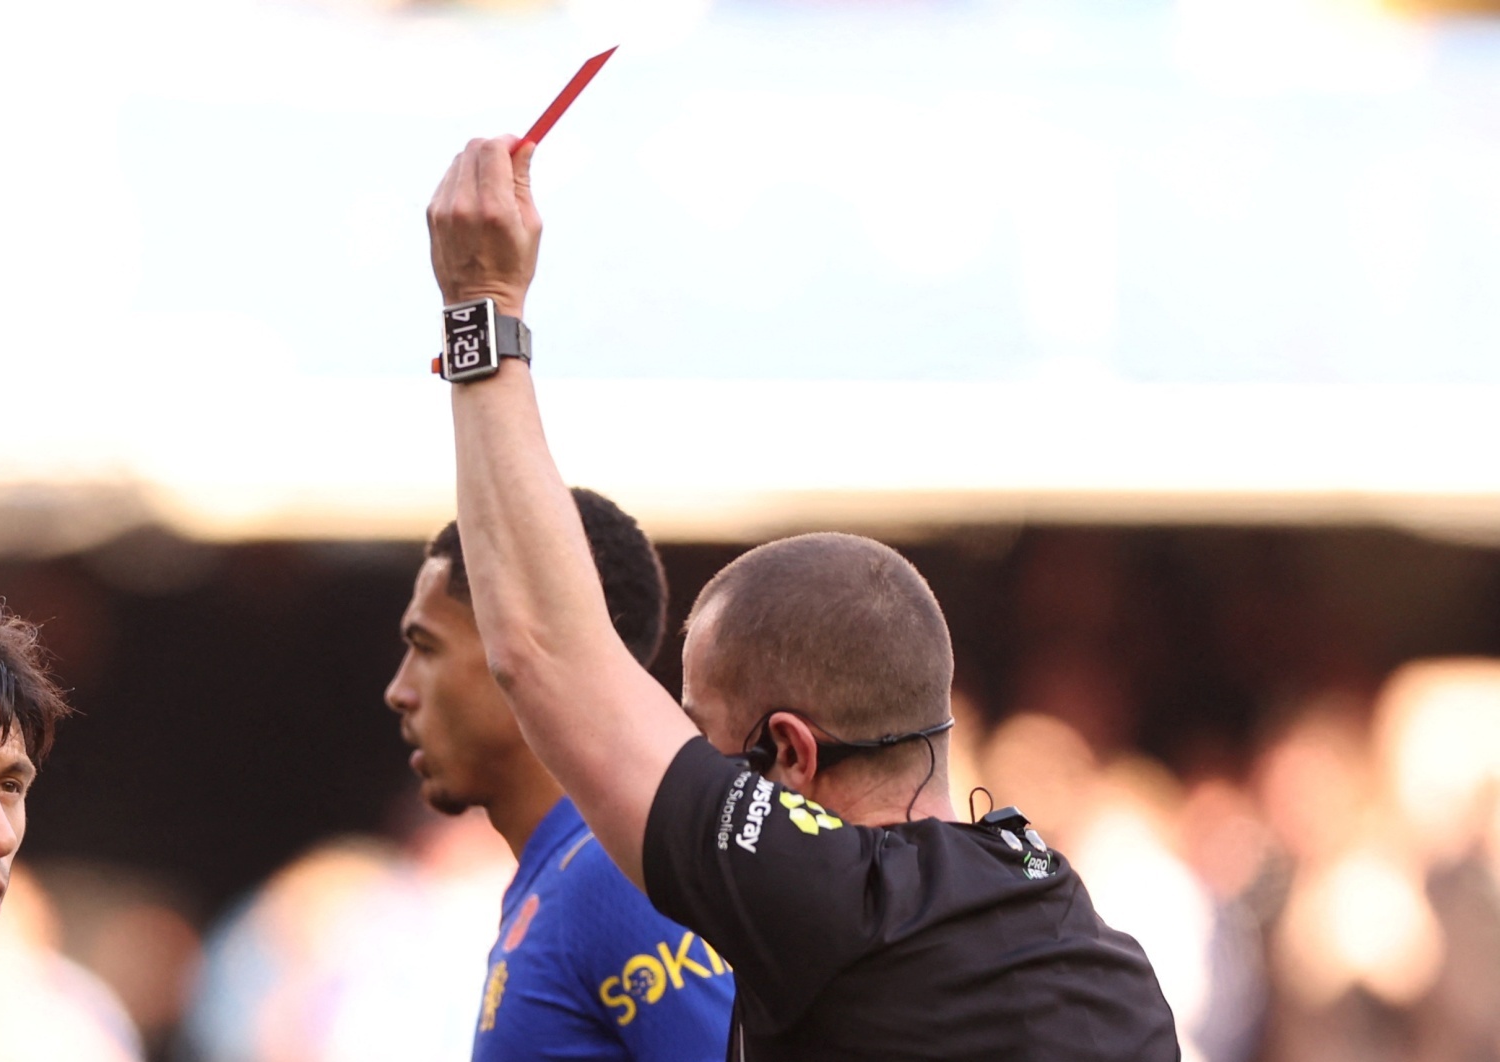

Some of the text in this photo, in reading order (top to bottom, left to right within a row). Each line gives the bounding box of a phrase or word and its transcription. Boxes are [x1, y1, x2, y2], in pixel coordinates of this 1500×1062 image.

[452, 306, 480, 369] 62:14
[735, 775, 775, 854] wsGray
[1027, 857, 1048, 870] PRO
[599, 930, 734, 1026] SOKI
